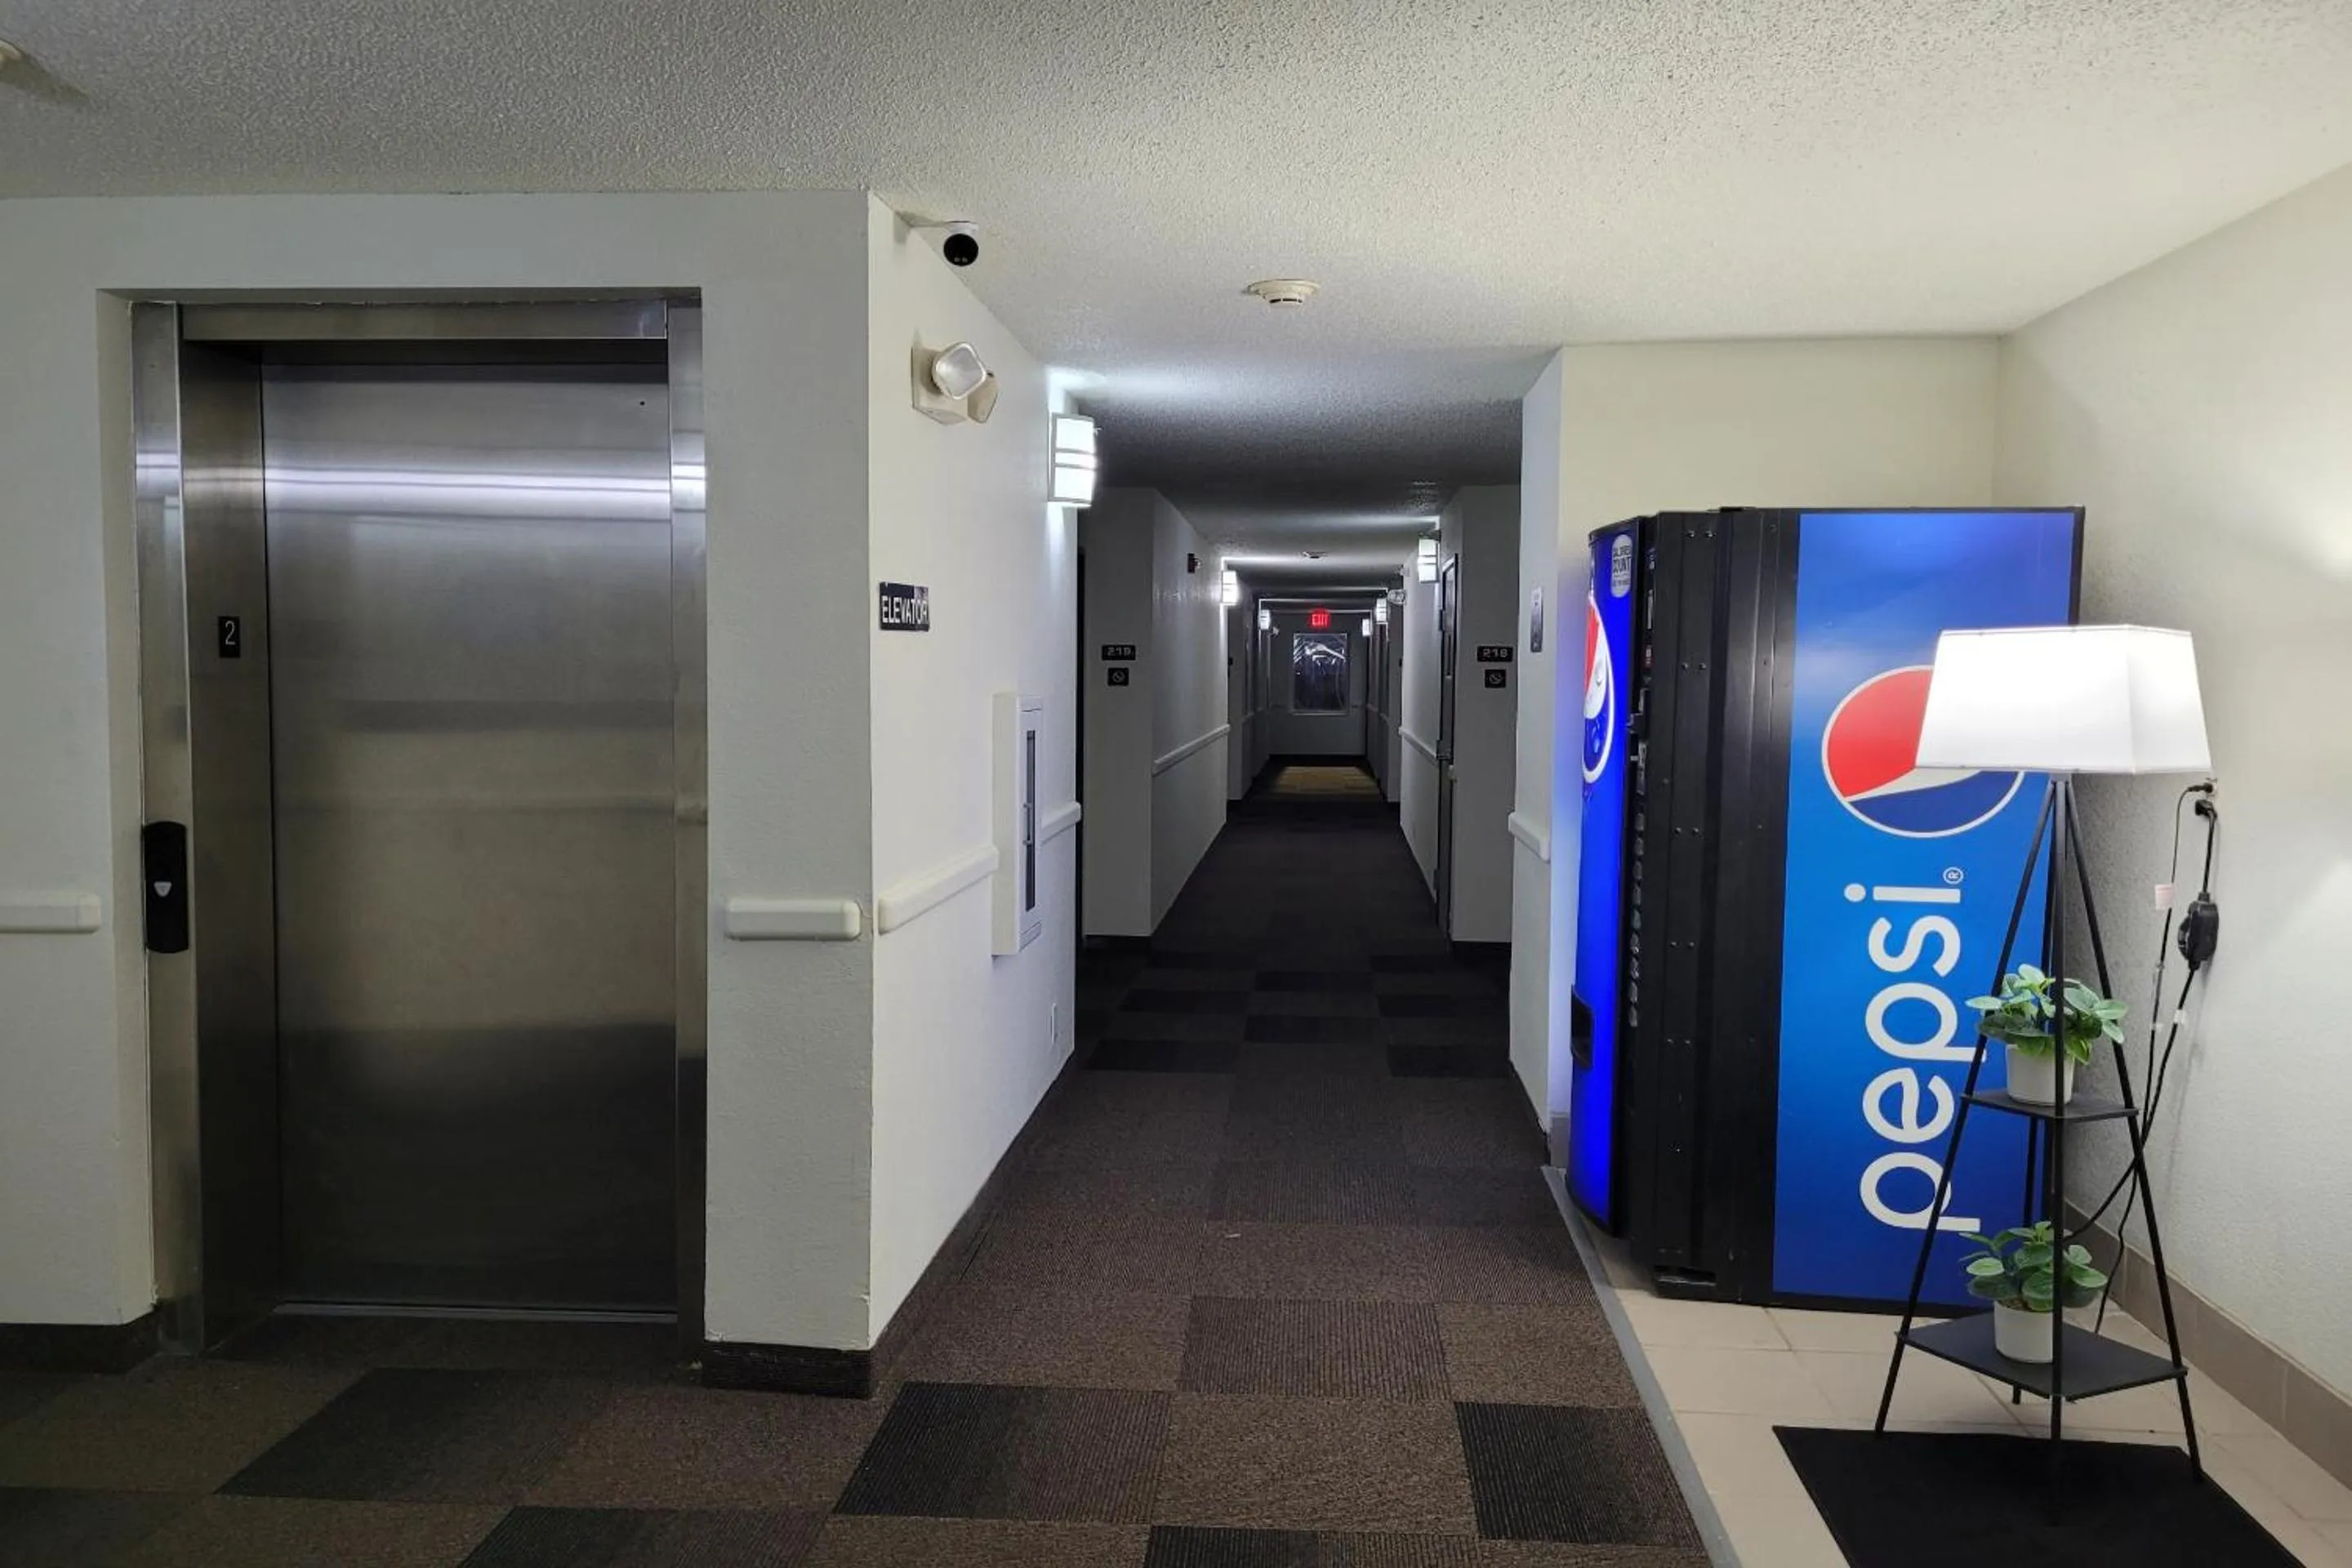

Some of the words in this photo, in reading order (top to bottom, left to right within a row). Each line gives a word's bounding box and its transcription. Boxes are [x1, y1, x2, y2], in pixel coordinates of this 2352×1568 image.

[881, 595, 928, 624] ELEVATOR
[1312, 614, 1330, 626] EXIT
[225, 620, 236, 645] 2
